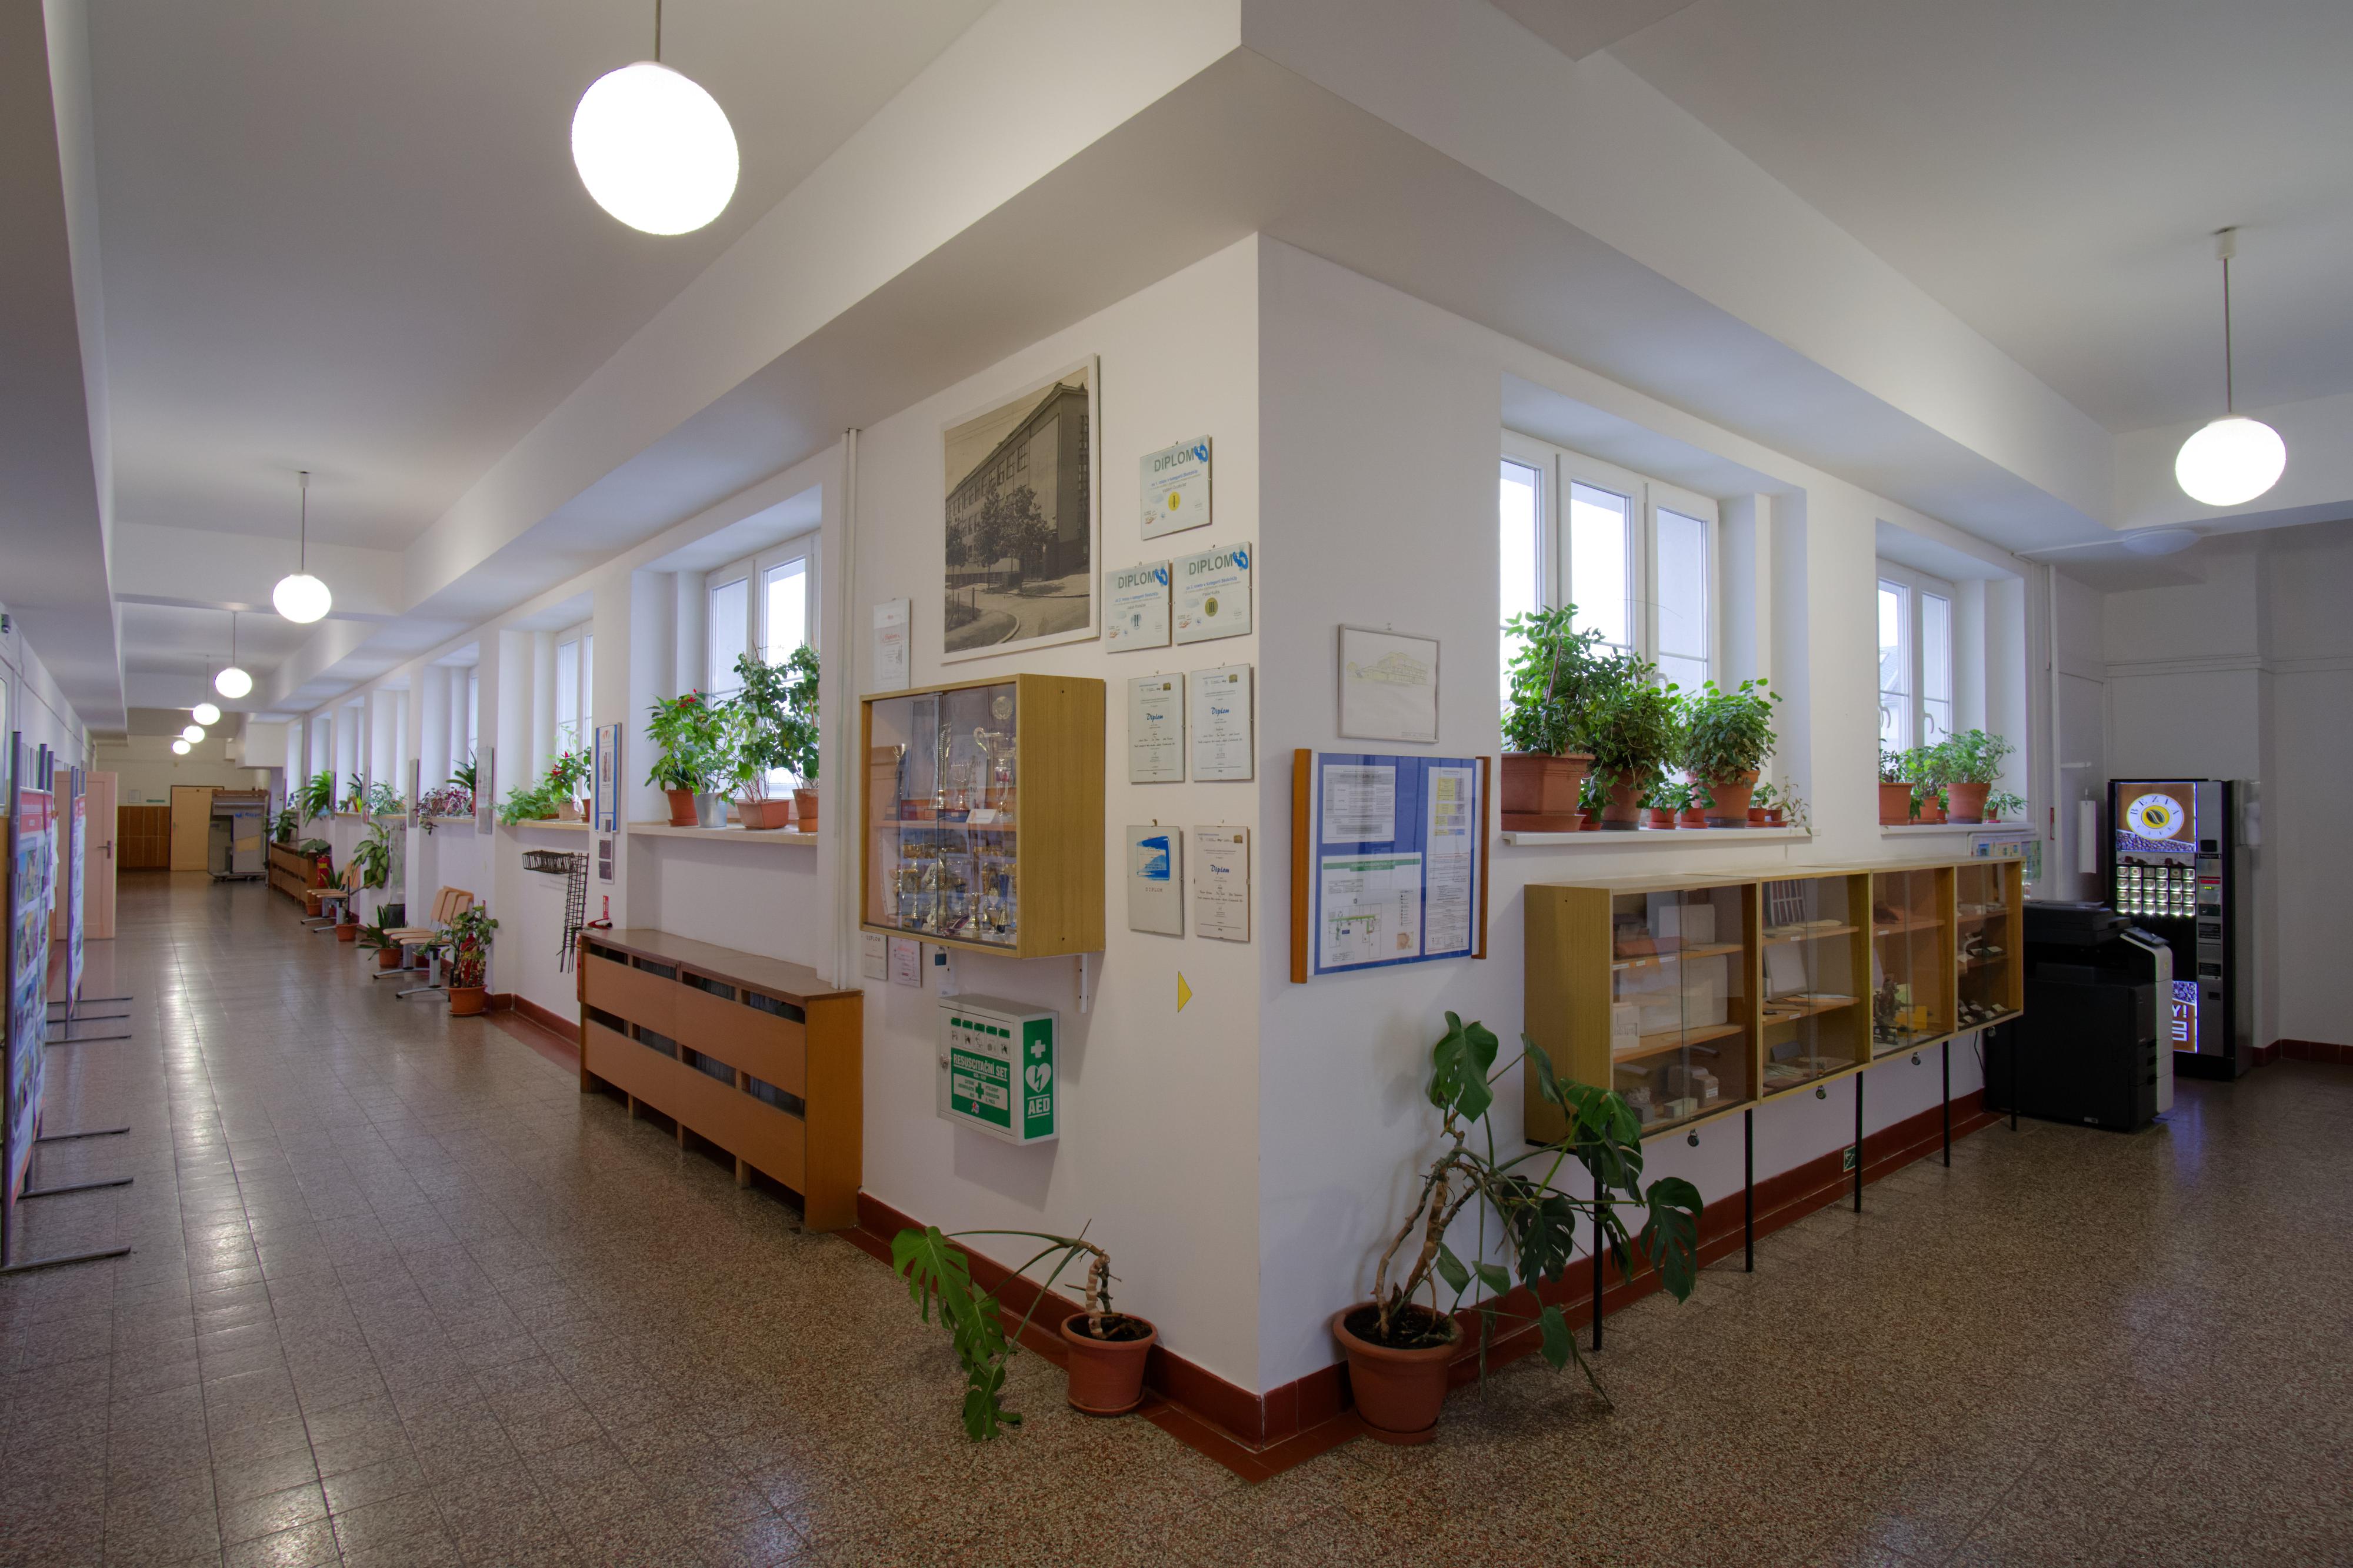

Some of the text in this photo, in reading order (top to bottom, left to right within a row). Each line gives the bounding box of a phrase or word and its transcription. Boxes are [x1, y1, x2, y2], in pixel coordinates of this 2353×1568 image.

[1154, 446, 1195, 472] DIPLOM
[1188, 553, 1234, 576] DIPLOM
[1118, 570, 1156, 589] DIPLOM
[1208, 600, 1216, 613] III
[1133, 613, 1139, 627] II
[1146, 713, 1164, 723] Diplom
[1210, 707, 1230, 717] Diplom
[1210, 865, 1230, 875] Diplom
[954, 1053, 995, 1075] RESUSCITAČNÍ
[996, 1065, 1008, 1078] SET
[1028, 1097, 1050, 1115] AED
